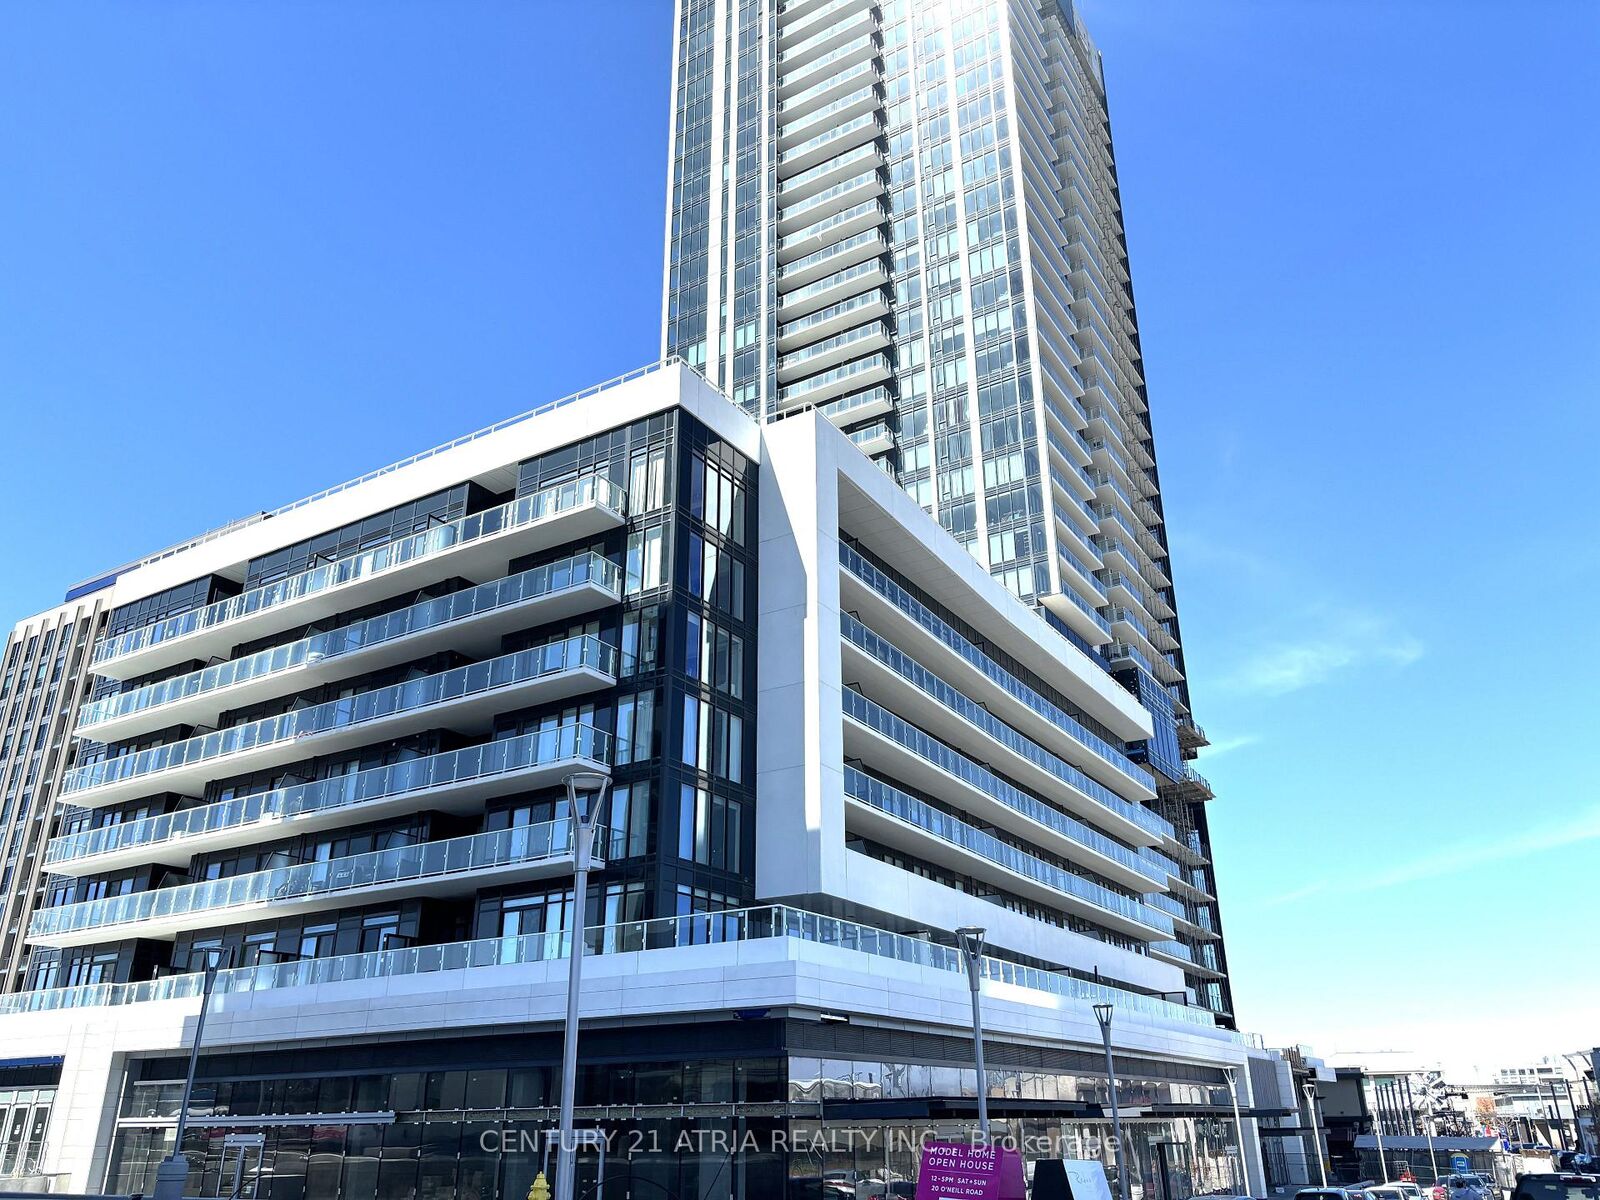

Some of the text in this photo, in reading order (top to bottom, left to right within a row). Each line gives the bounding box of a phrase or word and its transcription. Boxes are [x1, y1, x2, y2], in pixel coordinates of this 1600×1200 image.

[930, 1146, 996, 1159] MODEL HOME
[928, 1157, 995, 1171] OPEN HOUSE
[940, 1186, 964, 1194] O'NEILL
[965, 1188, 984, 1196] ROAD
